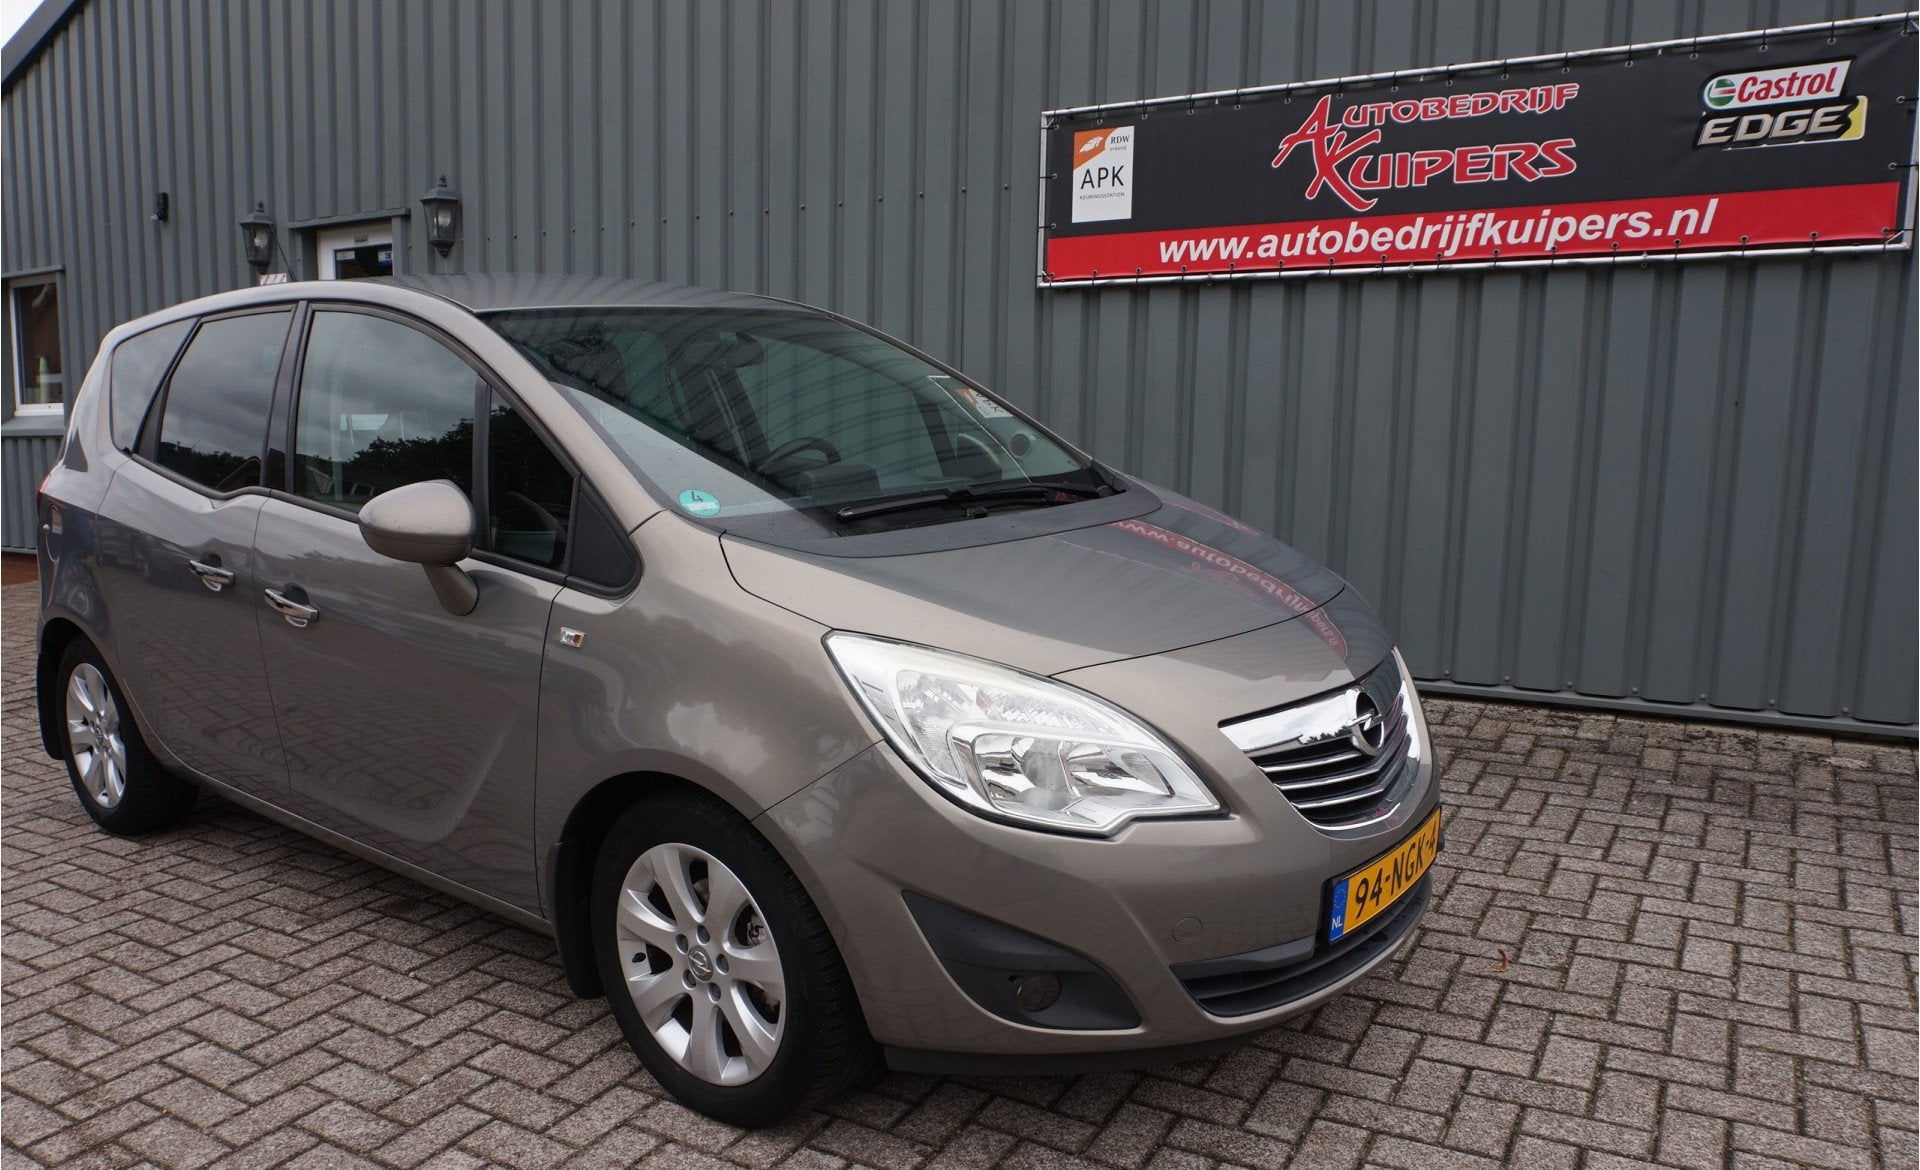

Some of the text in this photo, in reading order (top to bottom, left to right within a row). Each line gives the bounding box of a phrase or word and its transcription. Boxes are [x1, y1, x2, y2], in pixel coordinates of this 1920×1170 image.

[1738, 67, 1837, 103] Castrol
[1110, 135, 1130, 144] RDW
[1697, 104, 1852, 146] EDGE
[1080, 165, 1124, 190] APK
[1305, 129, 1577, 212] KUIPERS
[1080, 192, 1125, 200] KEURINGSSTATION
[1159, 198, 1719, 263] www.autobedrijfkuipers.nl
[690, 491, 704, 502] 4
[1355, 820, 1437, 918] 94-NGK-4
[1331, 917, 1343, 931] NL
